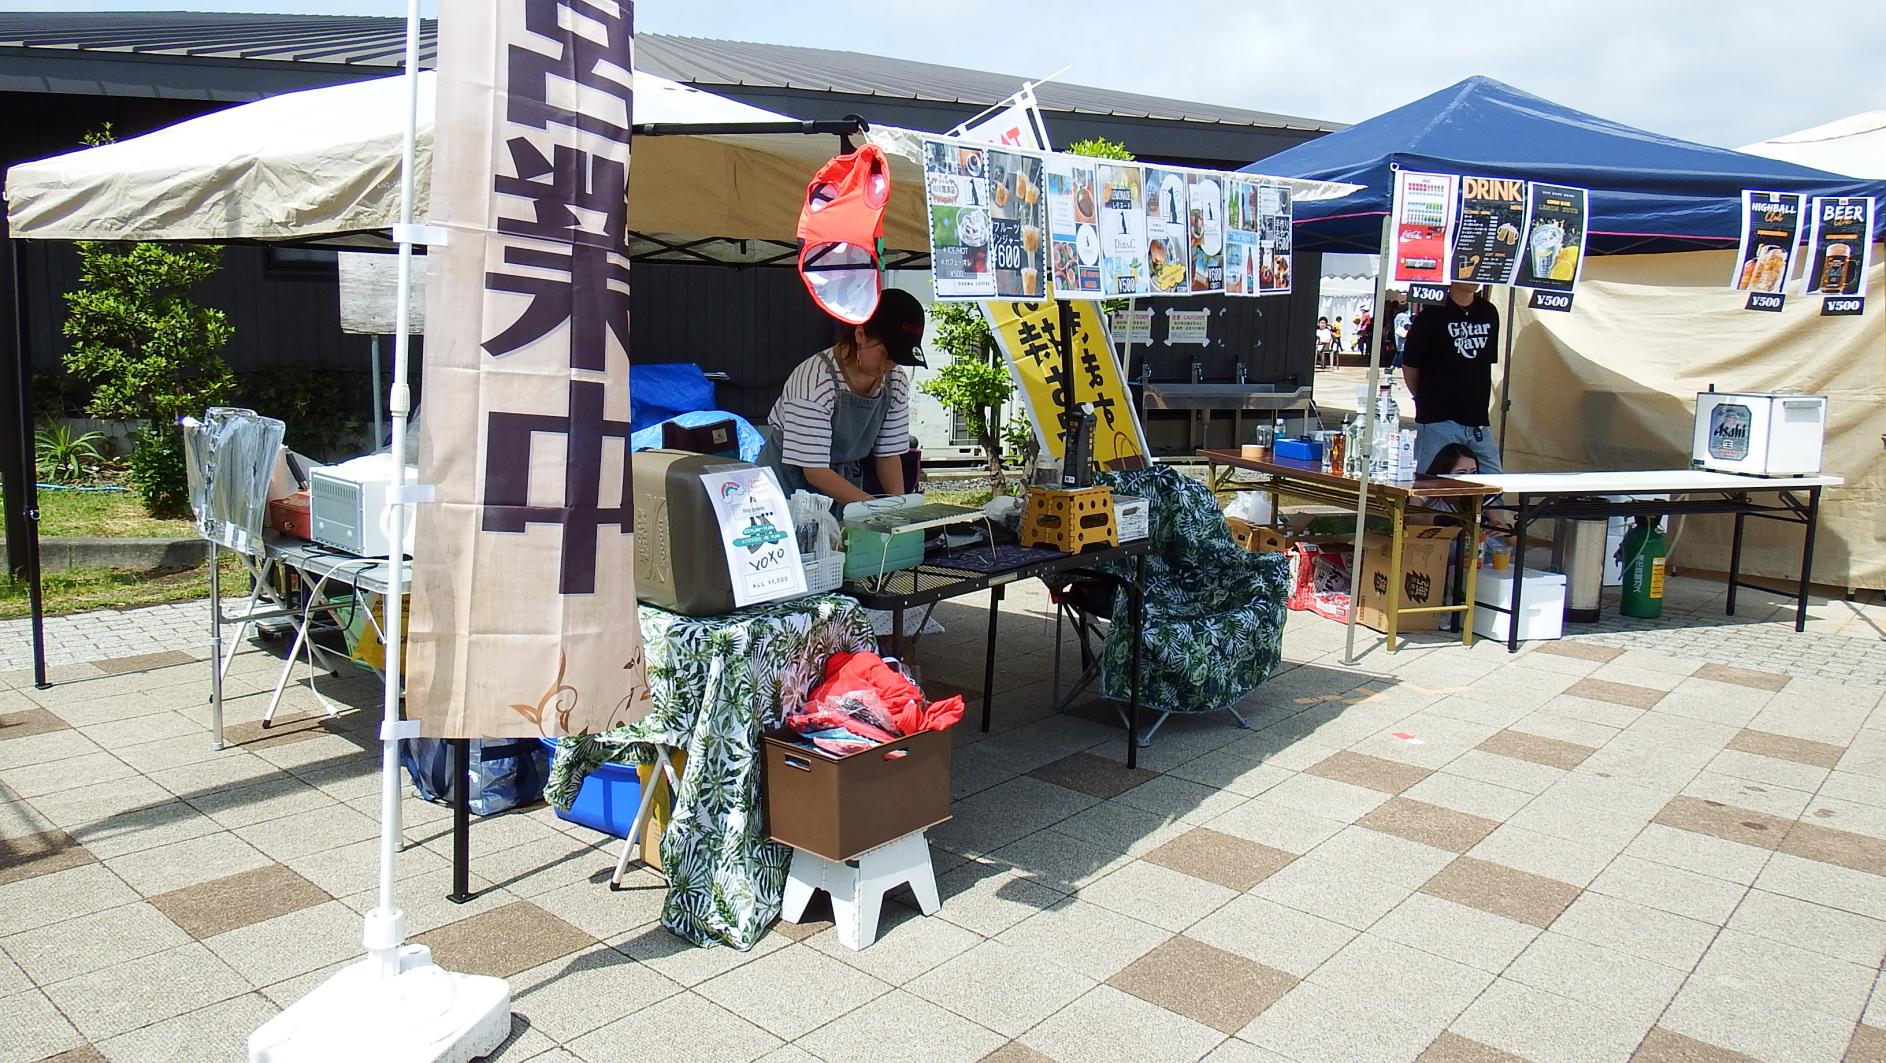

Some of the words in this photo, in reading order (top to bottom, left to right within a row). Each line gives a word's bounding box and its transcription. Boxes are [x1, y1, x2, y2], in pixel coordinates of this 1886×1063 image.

[1464, 179, 1523, 201] DRINK
[1752, 202, 1797, 214] HIGHBALL
[1823, 205, 1864, 222] BEER
[1413, 286, 1444, 301] ¥300
[1536, 294, 1568, 308] ¥500
[1752, 296, 1780, 308] ¥500
[1827, 301, 1860, 311] ¥500
[1714, 423, 1746, 438] Asahi
